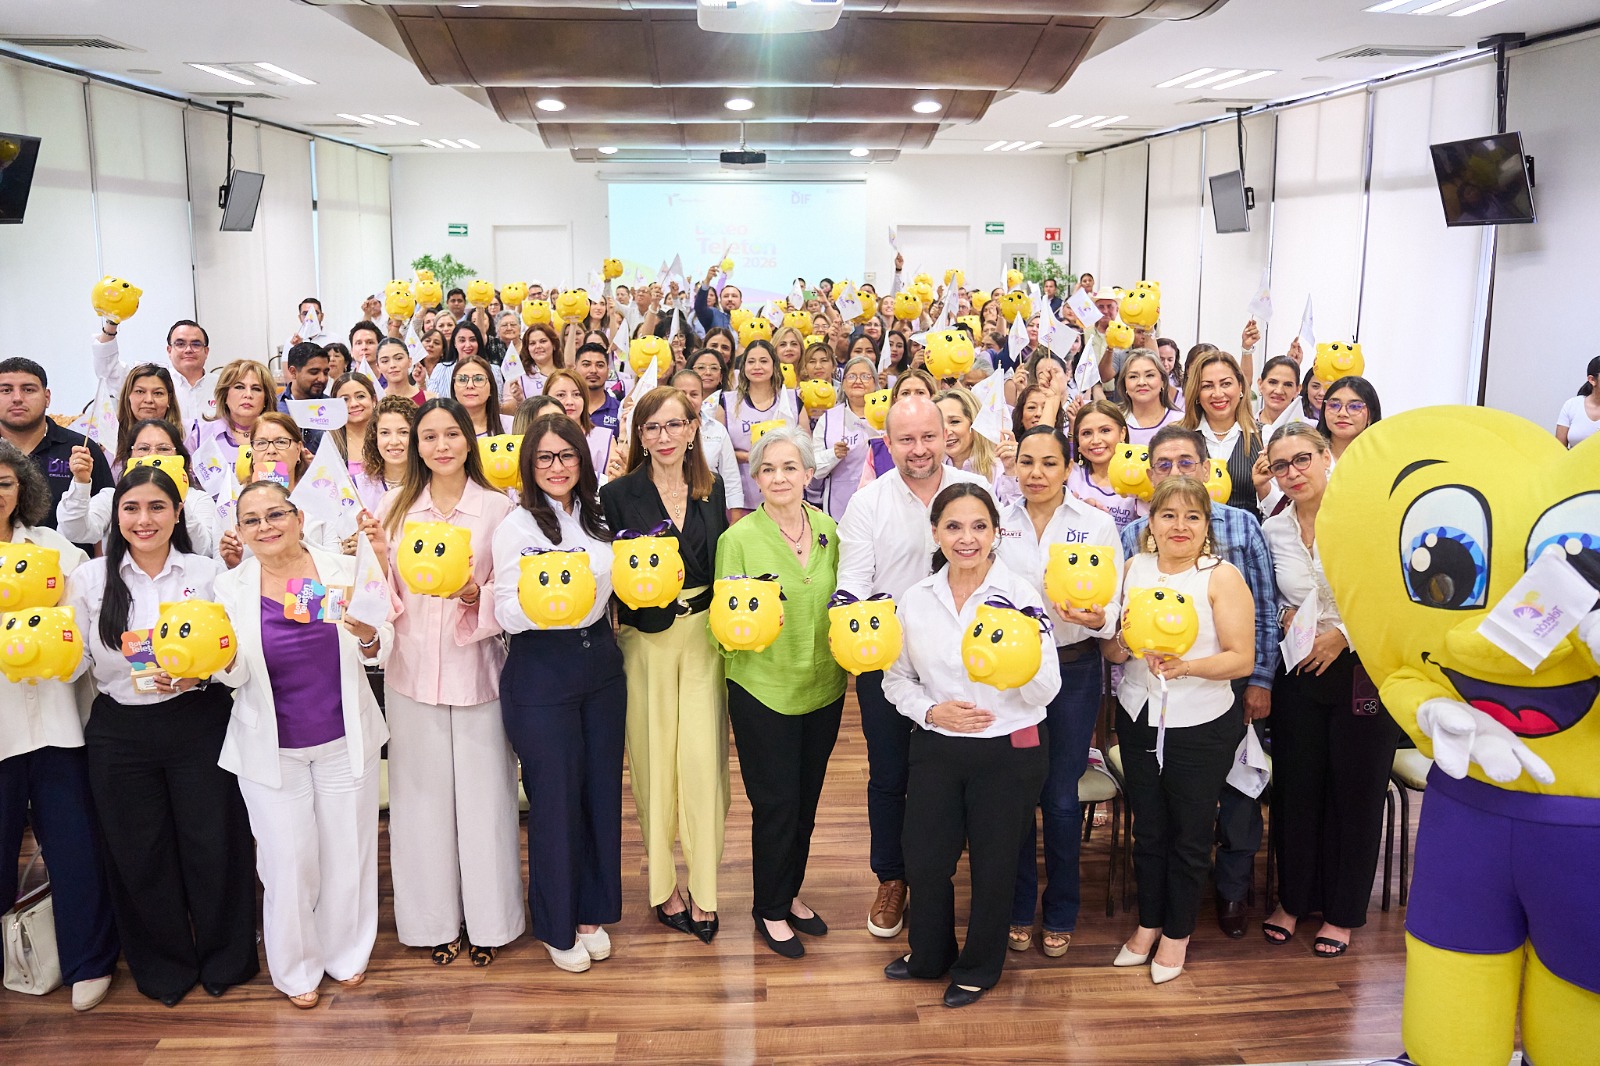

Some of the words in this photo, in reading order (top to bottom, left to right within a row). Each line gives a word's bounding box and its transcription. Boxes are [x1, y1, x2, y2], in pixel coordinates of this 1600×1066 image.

[742, 257, 776, 268] 2026
[300, 584, 311, 614] Teletón
[131, 645, 154, 653] Telet
